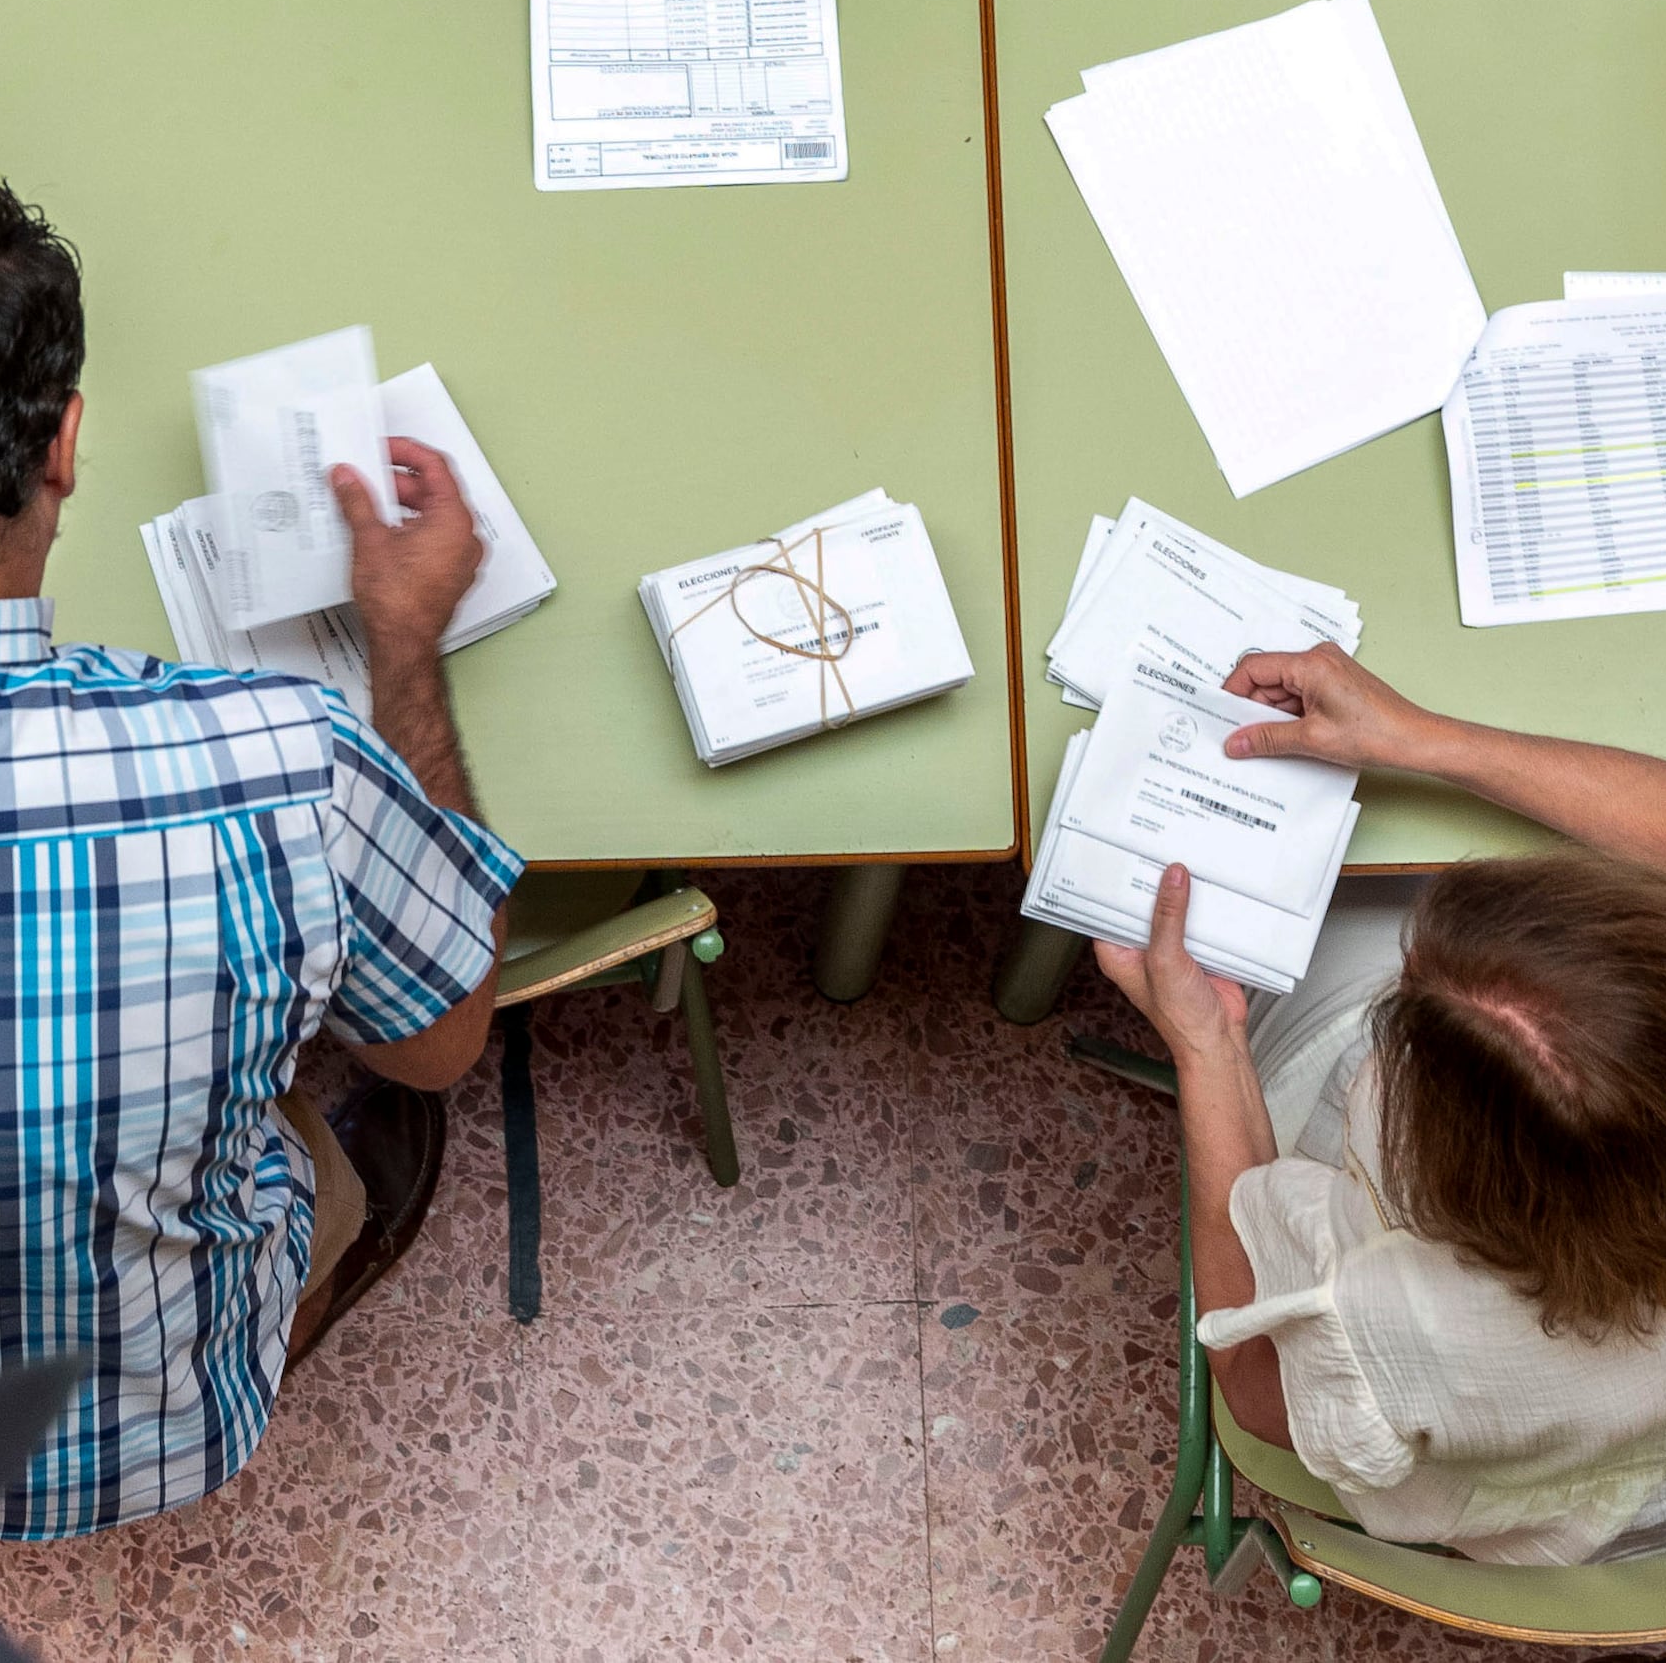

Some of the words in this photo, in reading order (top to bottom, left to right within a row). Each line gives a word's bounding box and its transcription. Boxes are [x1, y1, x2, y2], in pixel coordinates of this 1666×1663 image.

[679, 564, 741, 589] ELECCIONES
[1153, 540, 1207, 581] ELECCIONES
[1137, 663, 1197, 695] ELECCIONES
